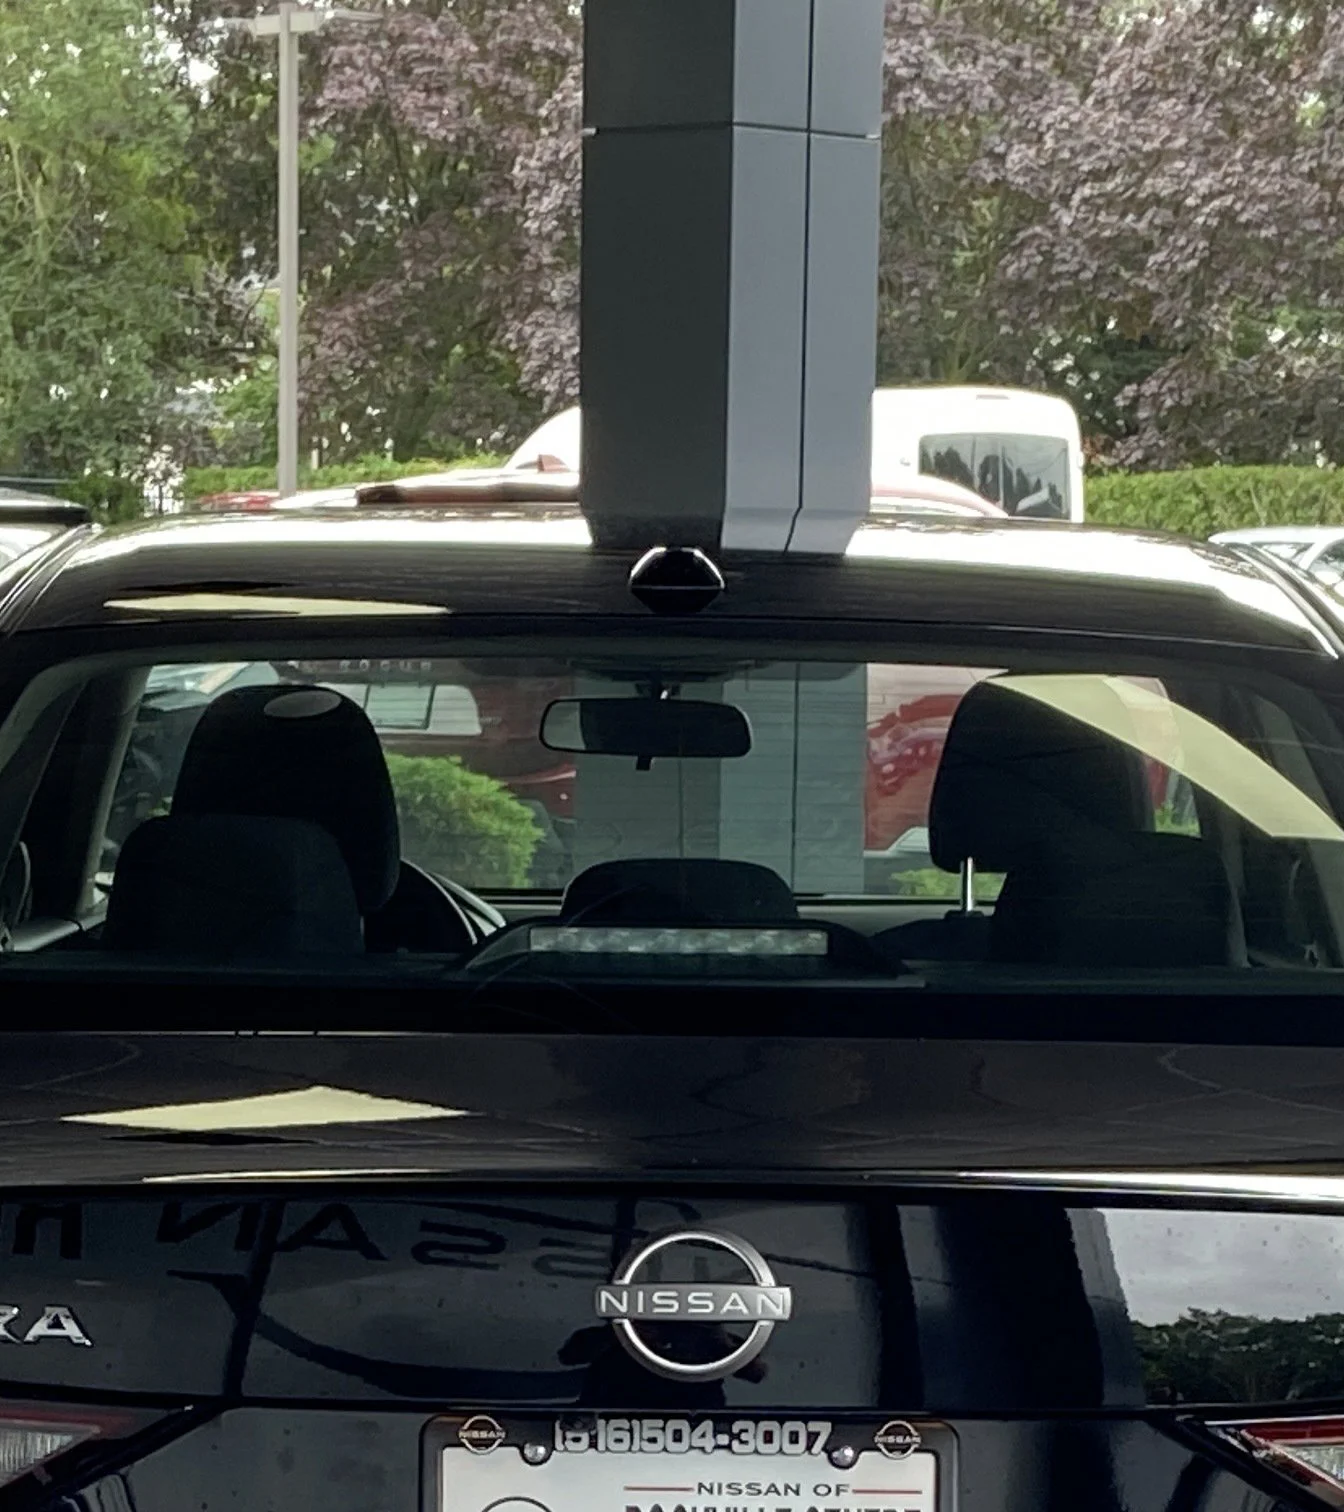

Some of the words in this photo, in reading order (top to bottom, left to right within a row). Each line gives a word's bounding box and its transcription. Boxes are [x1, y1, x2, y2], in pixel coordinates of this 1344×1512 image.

[599, 1289, 786, 1315] NISSAN
[697, 1481, 801, 1498] NISSAN
[812, 1483, 851, 1498] OF
